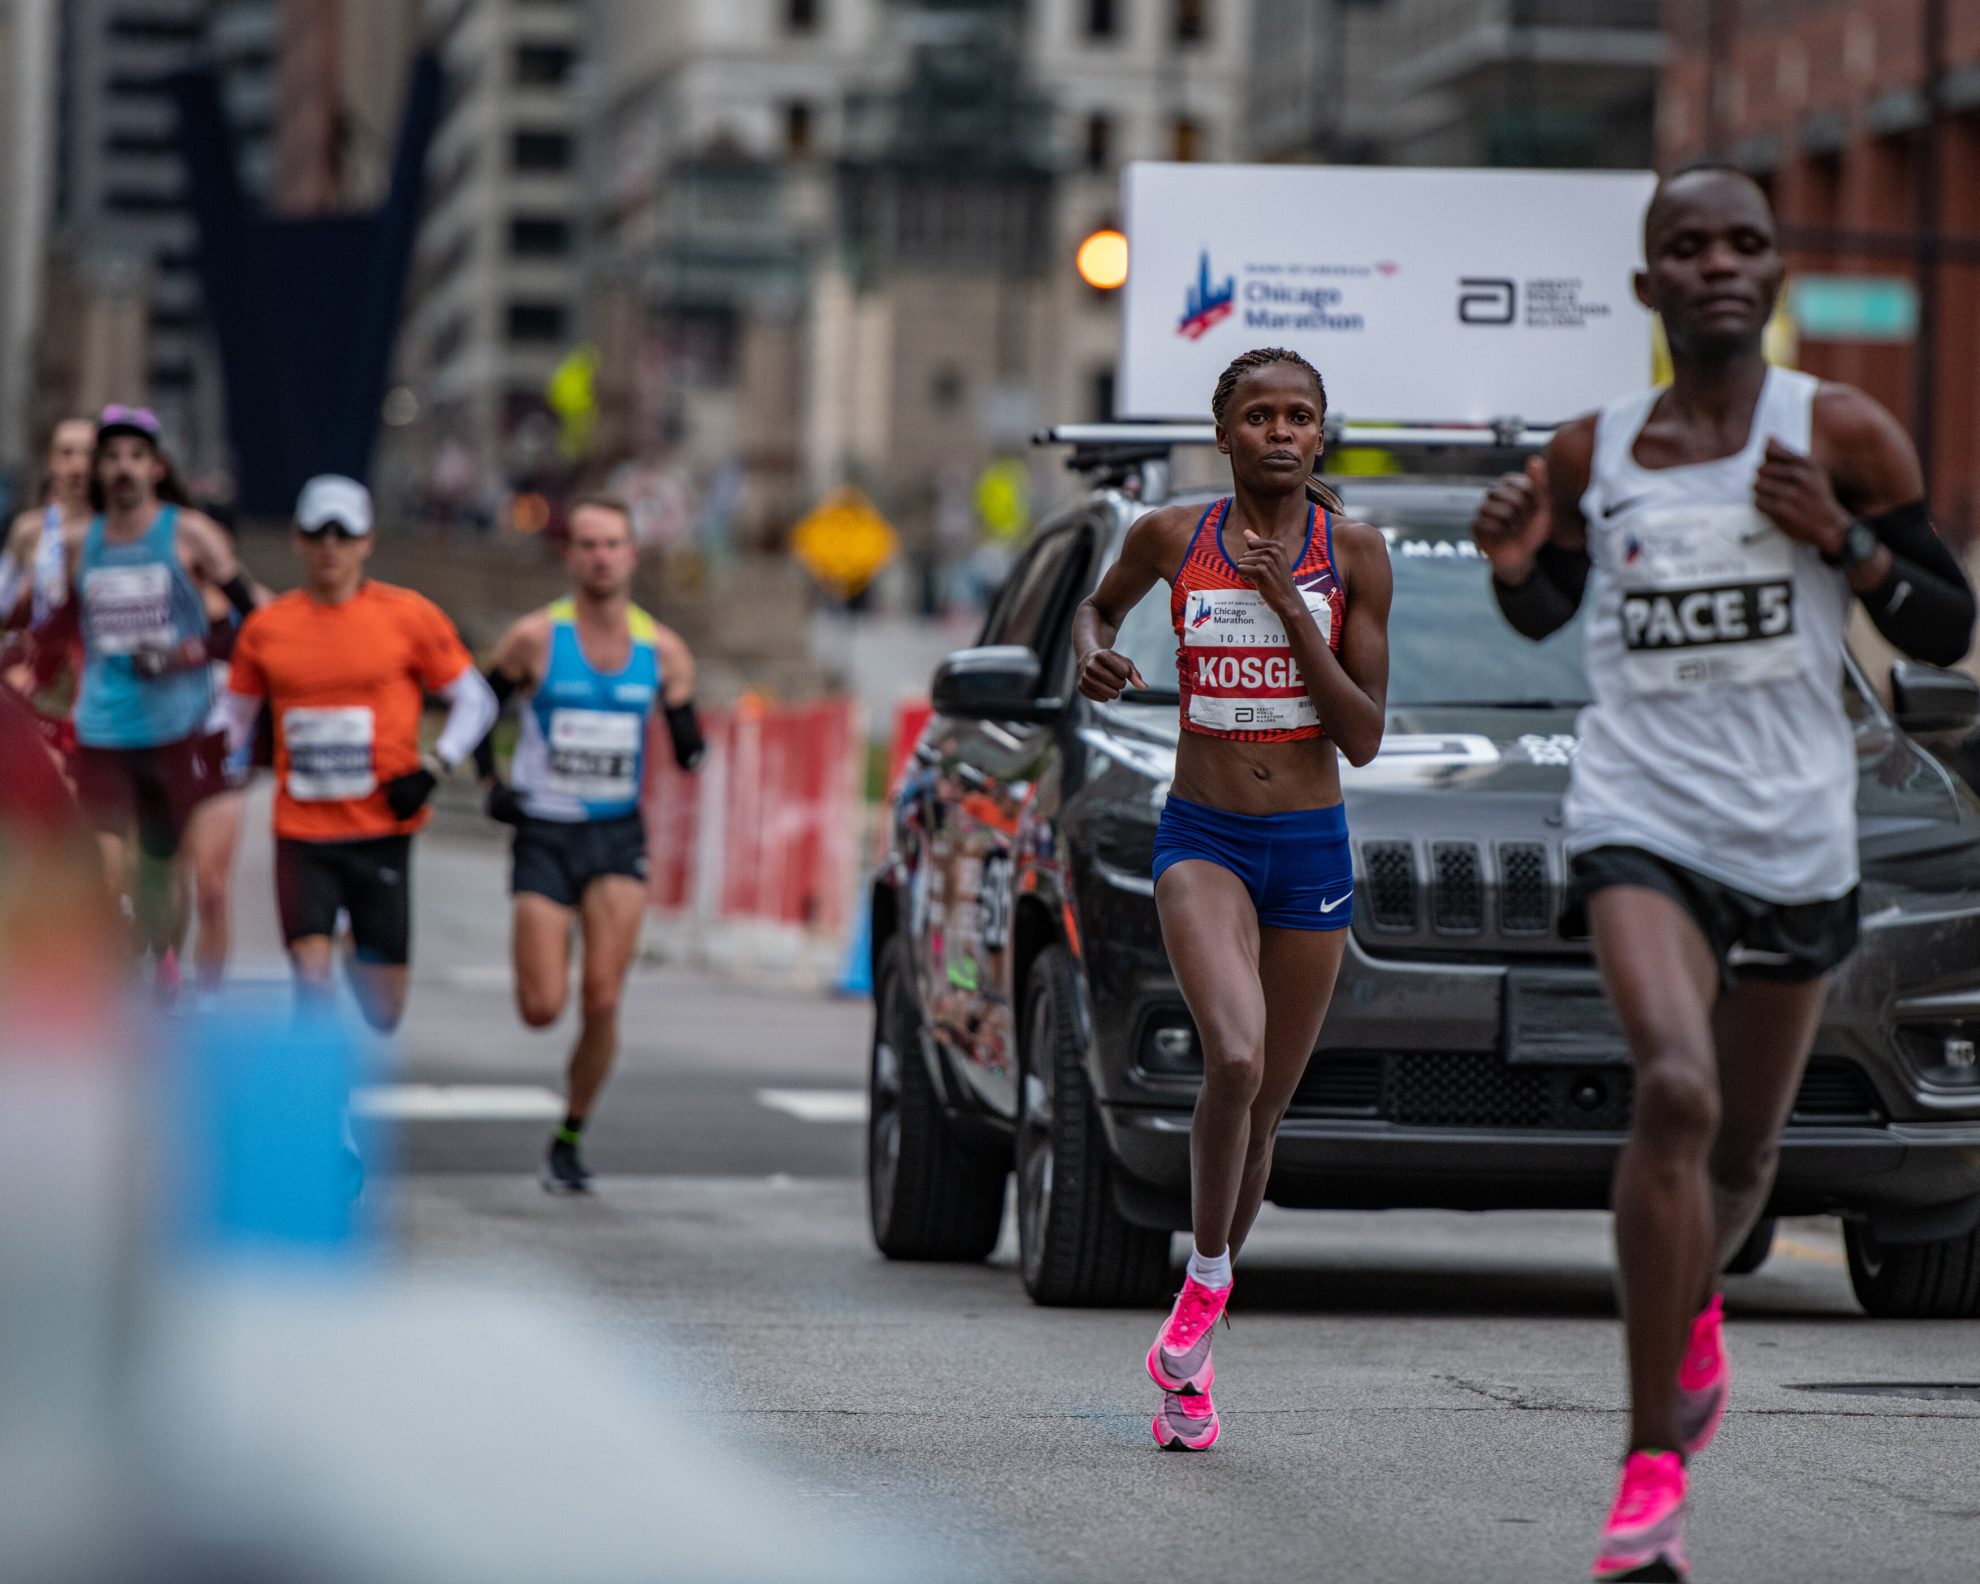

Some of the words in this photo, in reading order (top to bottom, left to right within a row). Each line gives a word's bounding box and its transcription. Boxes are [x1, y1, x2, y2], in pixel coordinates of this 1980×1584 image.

[1245, 281, 1342, 308] Chicago
[1245, 309, 1364, 329] Marathon
[1402, 540, 1488, 558] MAR
[1214, 607, 1247, 617] Chicago
[1214, 616, 1254, 624] Marathon
[1624, 590, 1748, 647] PACE
[1757, 584, 1789, 635] 5
[1198, 656, 1305, 688] KOSGE
